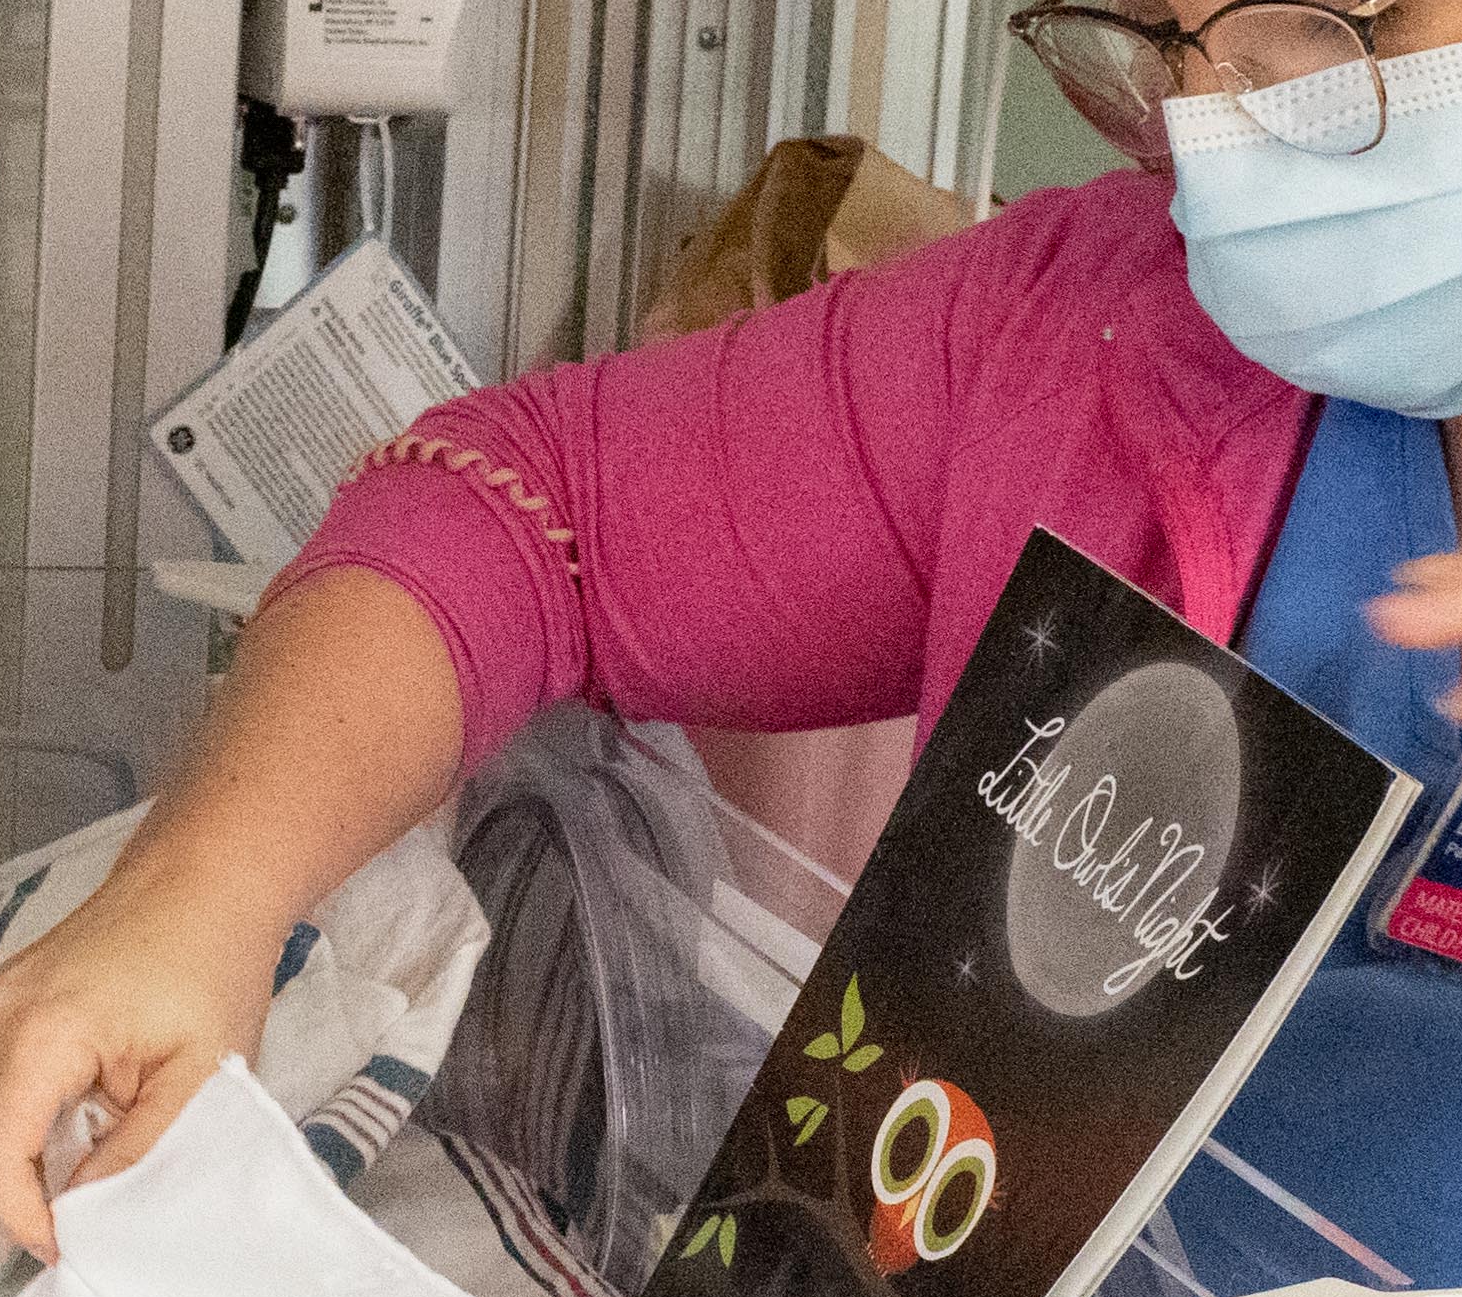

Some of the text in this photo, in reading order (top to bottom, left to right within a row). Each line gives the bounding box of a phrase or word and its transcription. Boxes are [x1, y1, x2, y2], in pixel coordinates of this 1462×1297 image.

[976, 715, 1236, 996] Little Owl's Night
